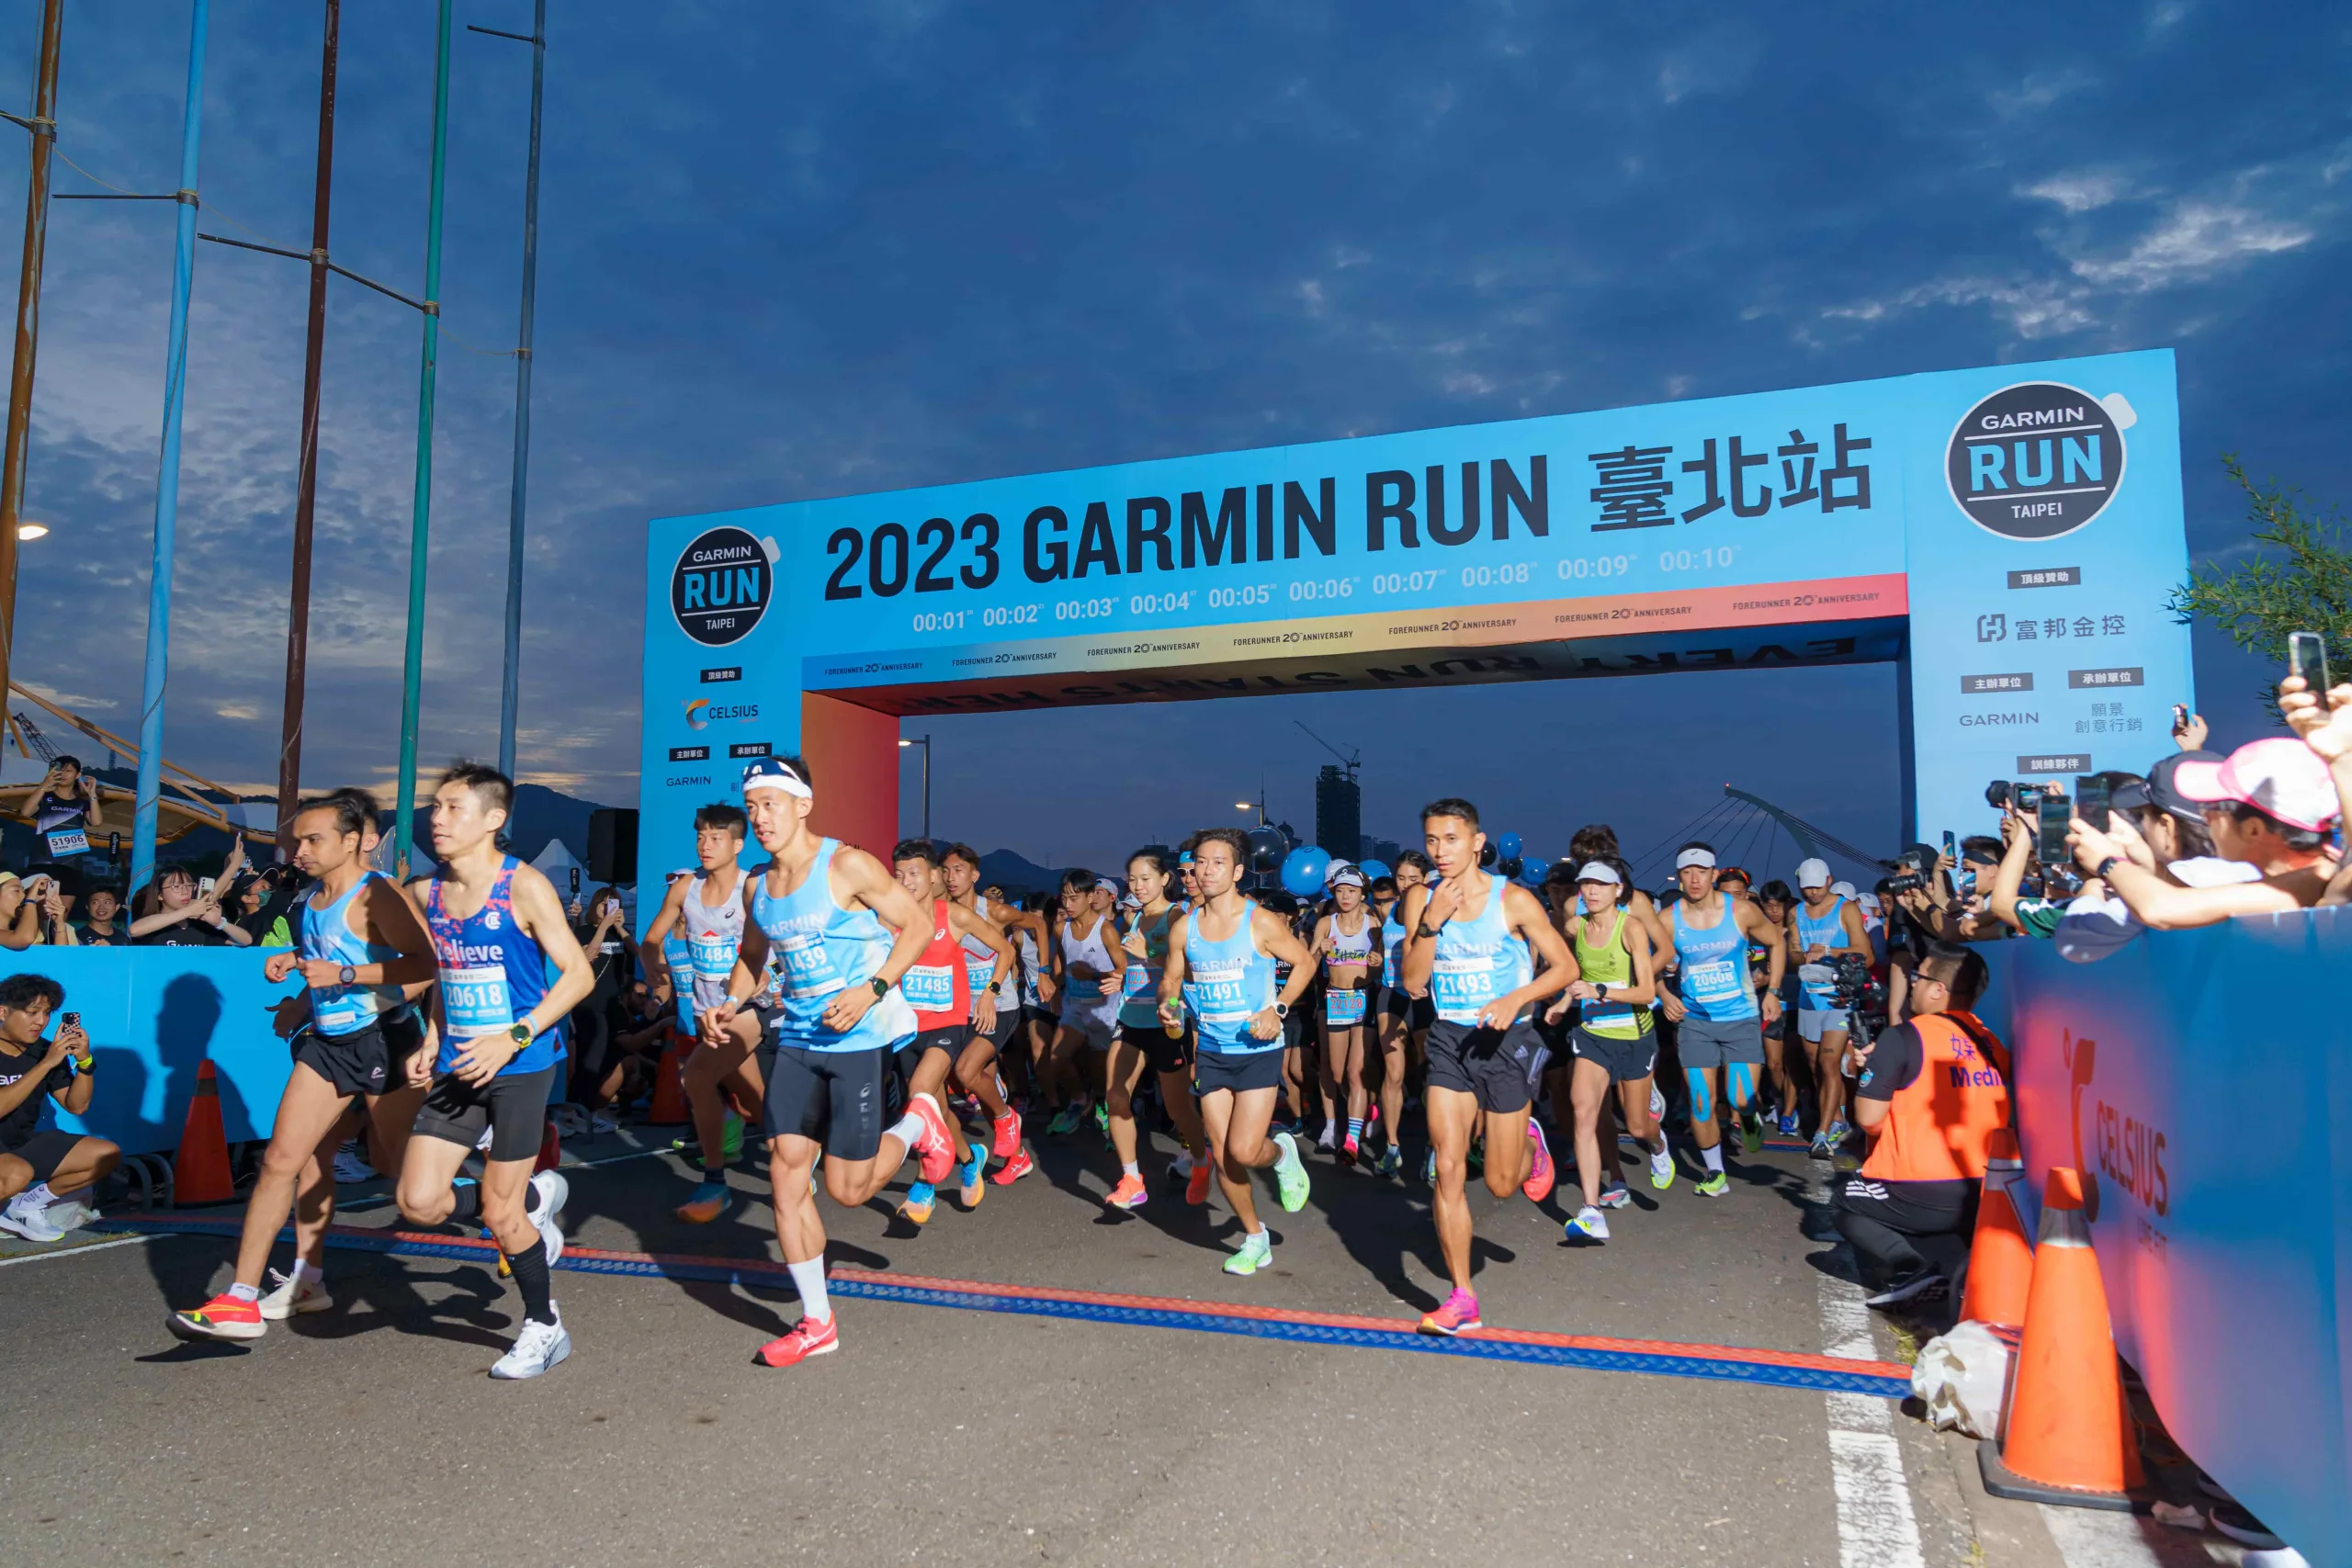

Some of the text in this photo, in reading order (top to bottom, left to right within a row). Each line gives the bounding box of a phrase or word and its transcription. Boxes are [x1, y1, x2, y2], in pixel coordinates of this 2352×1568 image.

[1981, 406, 2085, 430] GARMIN
[1966, 434, 2103, 491] RUN
[824, 423, 1872, 602] 2023 GARMIN RUN 臺北站
[2011, 502, 2063, 519] TAIPEI
[693, 545, 752, 562] GARMIN
[684, 566, 760, 609] RUN
[912, 610, 965, 632] 00:01
[983, 604, 1038, 626] 00:02
[1055, 597, 1113, 621] 00:03
[1130, 591, 1190, 615] 00:04
[1208, 584, 1270, 608] 00:05
[1289, 577, 1353, 602] 00:06
[1373, 570, 1438, 594] 00:07
[1461, 562, 1530, 587] 00:08
[1557, 554, 1629, 581] 00:09
[1659, 546, 1734, 572] 00:10
[1732, 599, 1791, 610] FORERUNNER
[1817, 592, 1880, 604] ANNIVERSARY
[706, 617, 735, 630] TAIPEI
[1555, 612, 1609, 624] FORERUNNER
[1634, 606, 1692, 617] ANNIVERSARY
[1388, 624, 1440, 635] FORERUNNER
[1462, 618, 1517, 629] ANNIVERSARY
[2015, 614, 2126, 641] 富邦金控
[1233, 636, 1281, 646] FORERUNNER
[1302, 630, 1354, 641] ANNIVERSARY
[1087, 647, 1132, 656] FORERUNNER
[1152, 641, 1201, 652] ANNIVERSARY
[1577, 637, 1856, 672] EVERY
[952, 657, 993, 666] FORERUNNER
[1012, 652, 1057, 662] ANNIVERSARY
[824, 666, 864, 676] FORERUNNER
[881, 662, 923, 671] ANNIVERSARY
[1365, 655, 1544, 684] RUN
[1060, 671, 1349, 700] STARTS
[708, 705, 759, 720] CELSIUS
[1959, 712, 2040, 727] GARMIN
[2075, 716, 2143, 734] 創意行銷
[666, 775, 712, 787] GARMIN
[51, 835, 85, 847] 51906
[691, 945, 734, 962] 21484
[1681, 940, 1737, 953] GARMIN
[969, 968, 993, 982] 232
[1437, 972, 1492, 994] 21493
[905, 976, 950, 993] 21485
[1197, 981, 1242, 1000] 21491
[446, 983, 503, 1008] 20618
[1329, 997, 1363, 1010] 22128
[1950, 1065, 2006, 1089] Medi
[2097, 1100, 2168, 1217] CELSIUS
